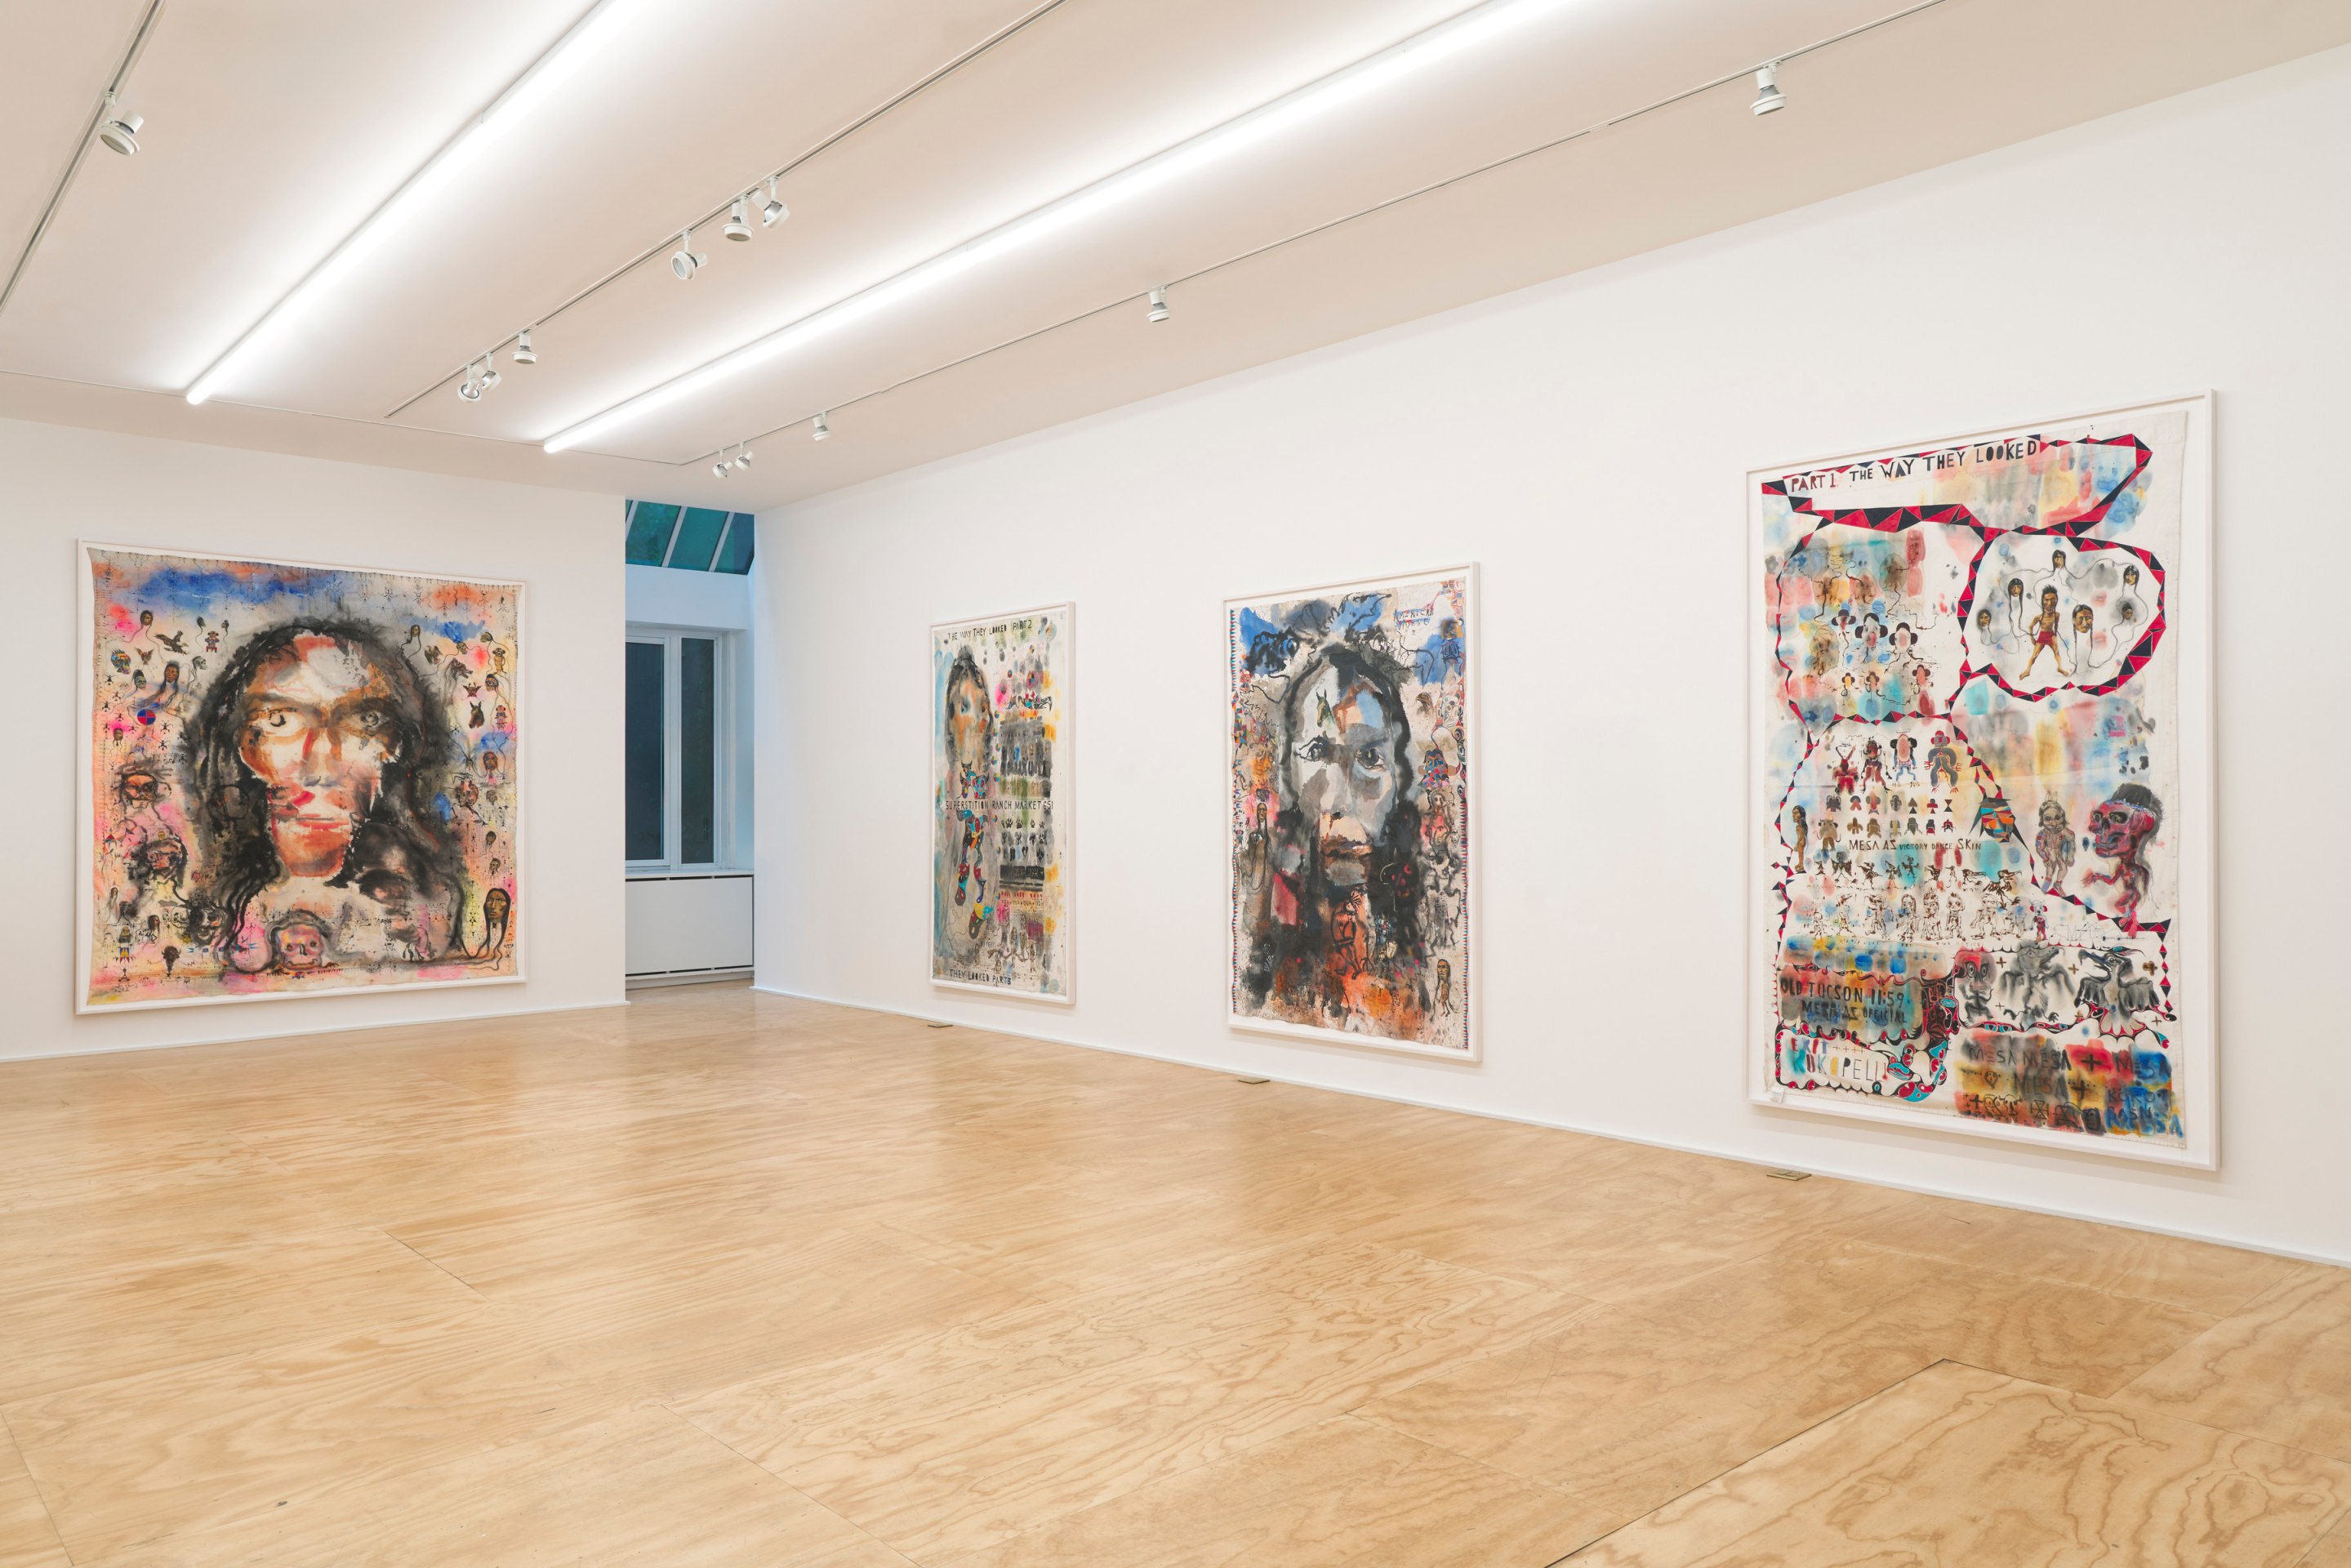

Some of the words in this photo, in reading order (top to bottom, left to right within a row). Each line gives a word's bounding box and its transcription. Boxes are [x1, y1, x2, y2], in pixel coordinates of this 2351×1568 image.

[1791, 474, 1826, 492] PART
[1829, 473, 1837, 488] 1
[1850, 468, 1873, 482] THE
[1878, 459, 1915, 479] WAY
[1922, 451, 1966, 471] THEY
[1976, 440, 2037, 464] LOOKED
[973, 627, 986, 637] THEY
[989, 624, 1007, 635] LOOKED
[1013, 620, 1027, 631] PART
[1027, 619, 1032, 629] 2
[945, 800, 989, 810] SUPERSTITION
[991, 800, 1012, 810] RANCH
[1014, 800, 1041, 810] MARKET
[1849, 840, 1880, 850] MESA
[949, 969, 966, 979] THEY
[968, 971, 990, 982] LOOKED
[992, 975, 1008, 985] PART
[1780, 978, 1802, 996] OLD
[1809, 982, 1863, 1004] TUCSON
[1871, 988, 1904, 1009] 11:59
[1863, 1005, 1908, 1023] OFFICIAL
[1790, 1037, 1830, 1054] EXIT
